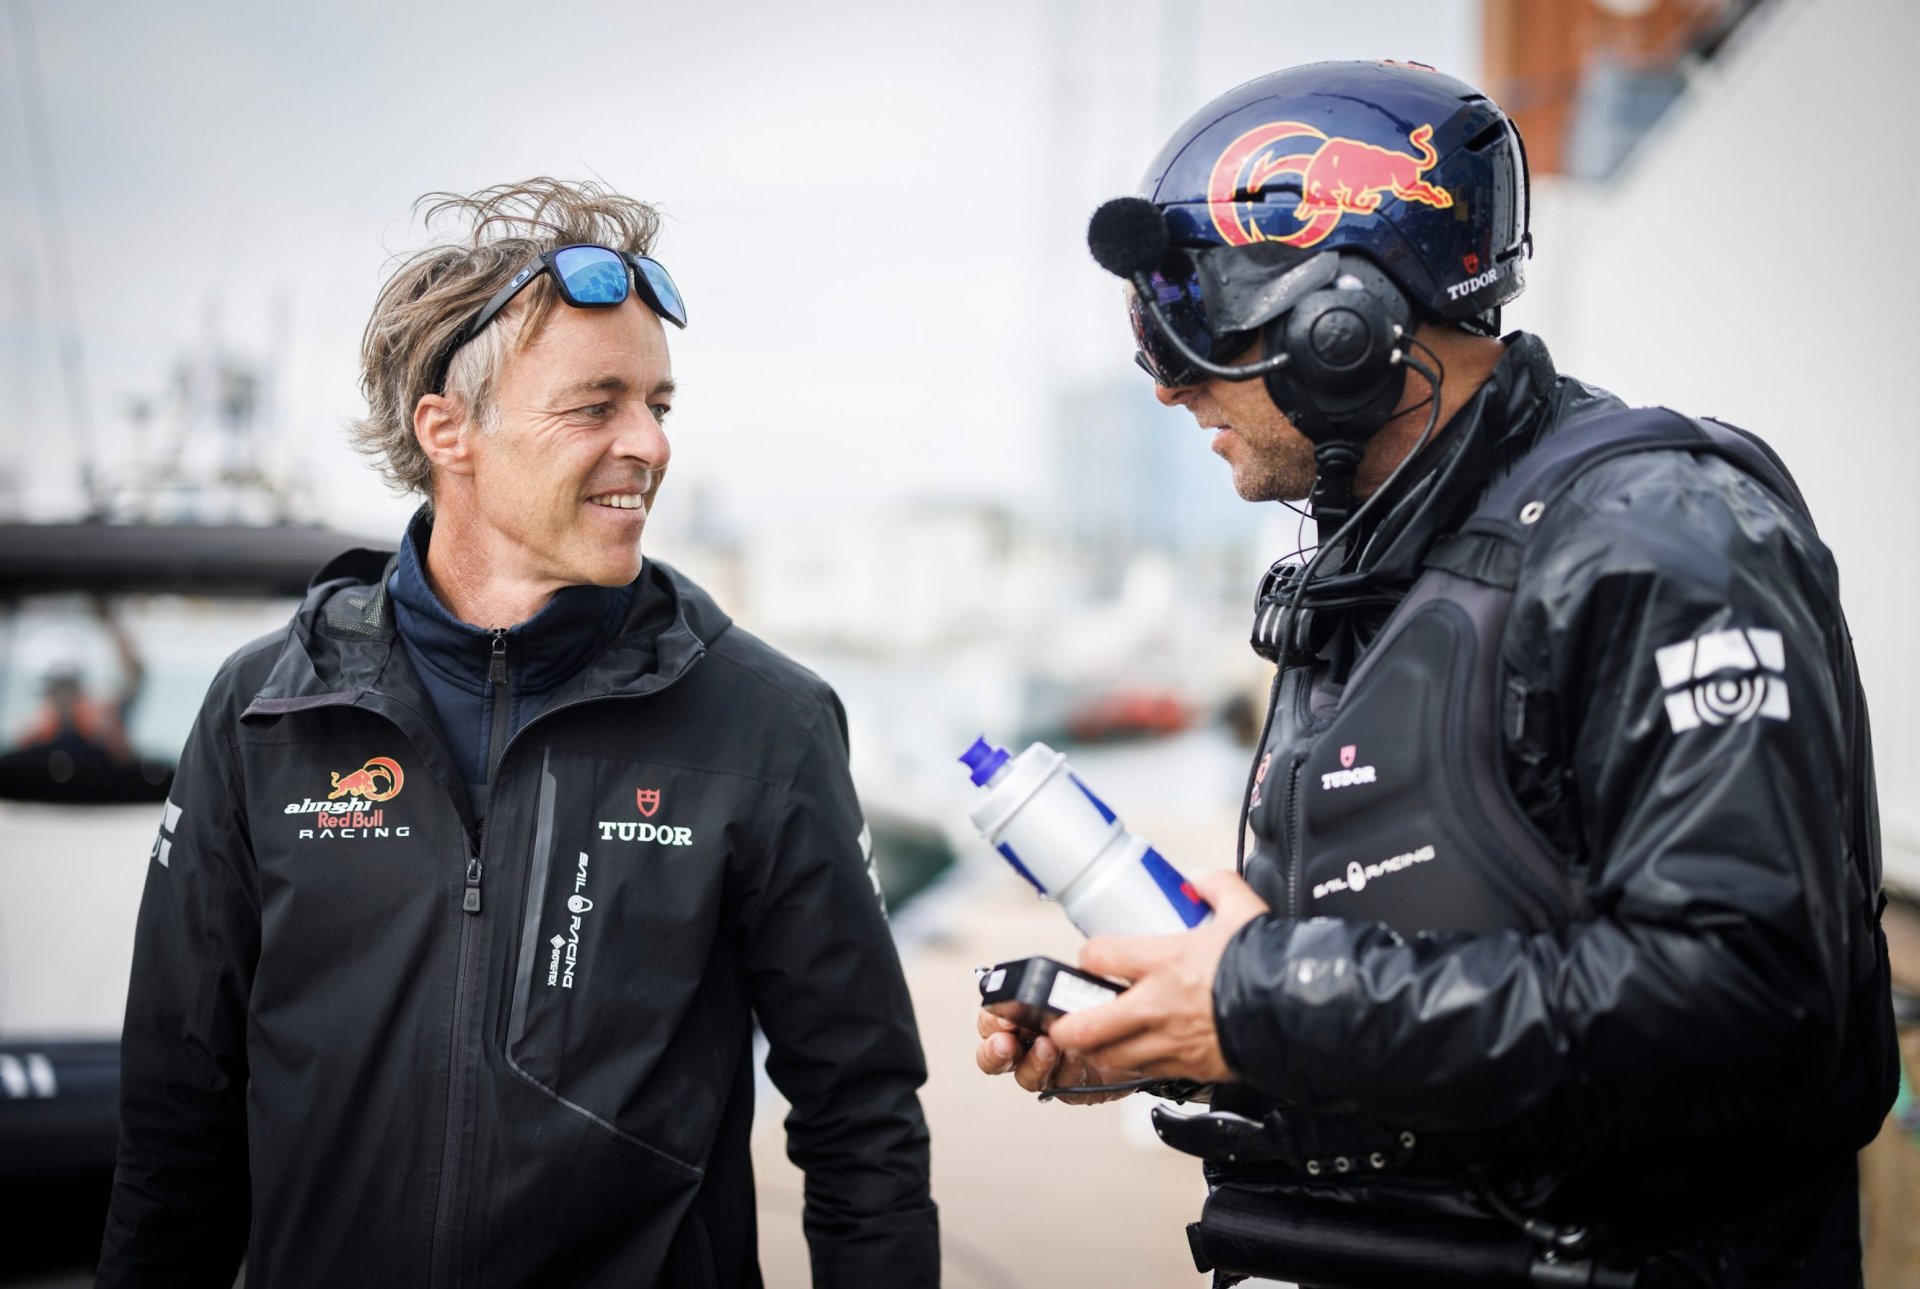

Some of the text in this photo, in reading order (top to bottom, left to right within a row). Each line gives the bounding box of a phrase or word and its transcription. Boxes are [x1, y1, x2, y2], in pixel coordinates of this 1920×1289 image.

[1447, 268, 1498, 300] TUDOR
[1321, 765, 1377, 790] TUDOR
[284, 797, 373, 815] alinghi
[318, 809, 384, 828] Red Bull
[299, 826, 410, 840] RACING
[599, 821, 693, 846] TUDOR
[562, 851, 589, 989] SAIL RACING
